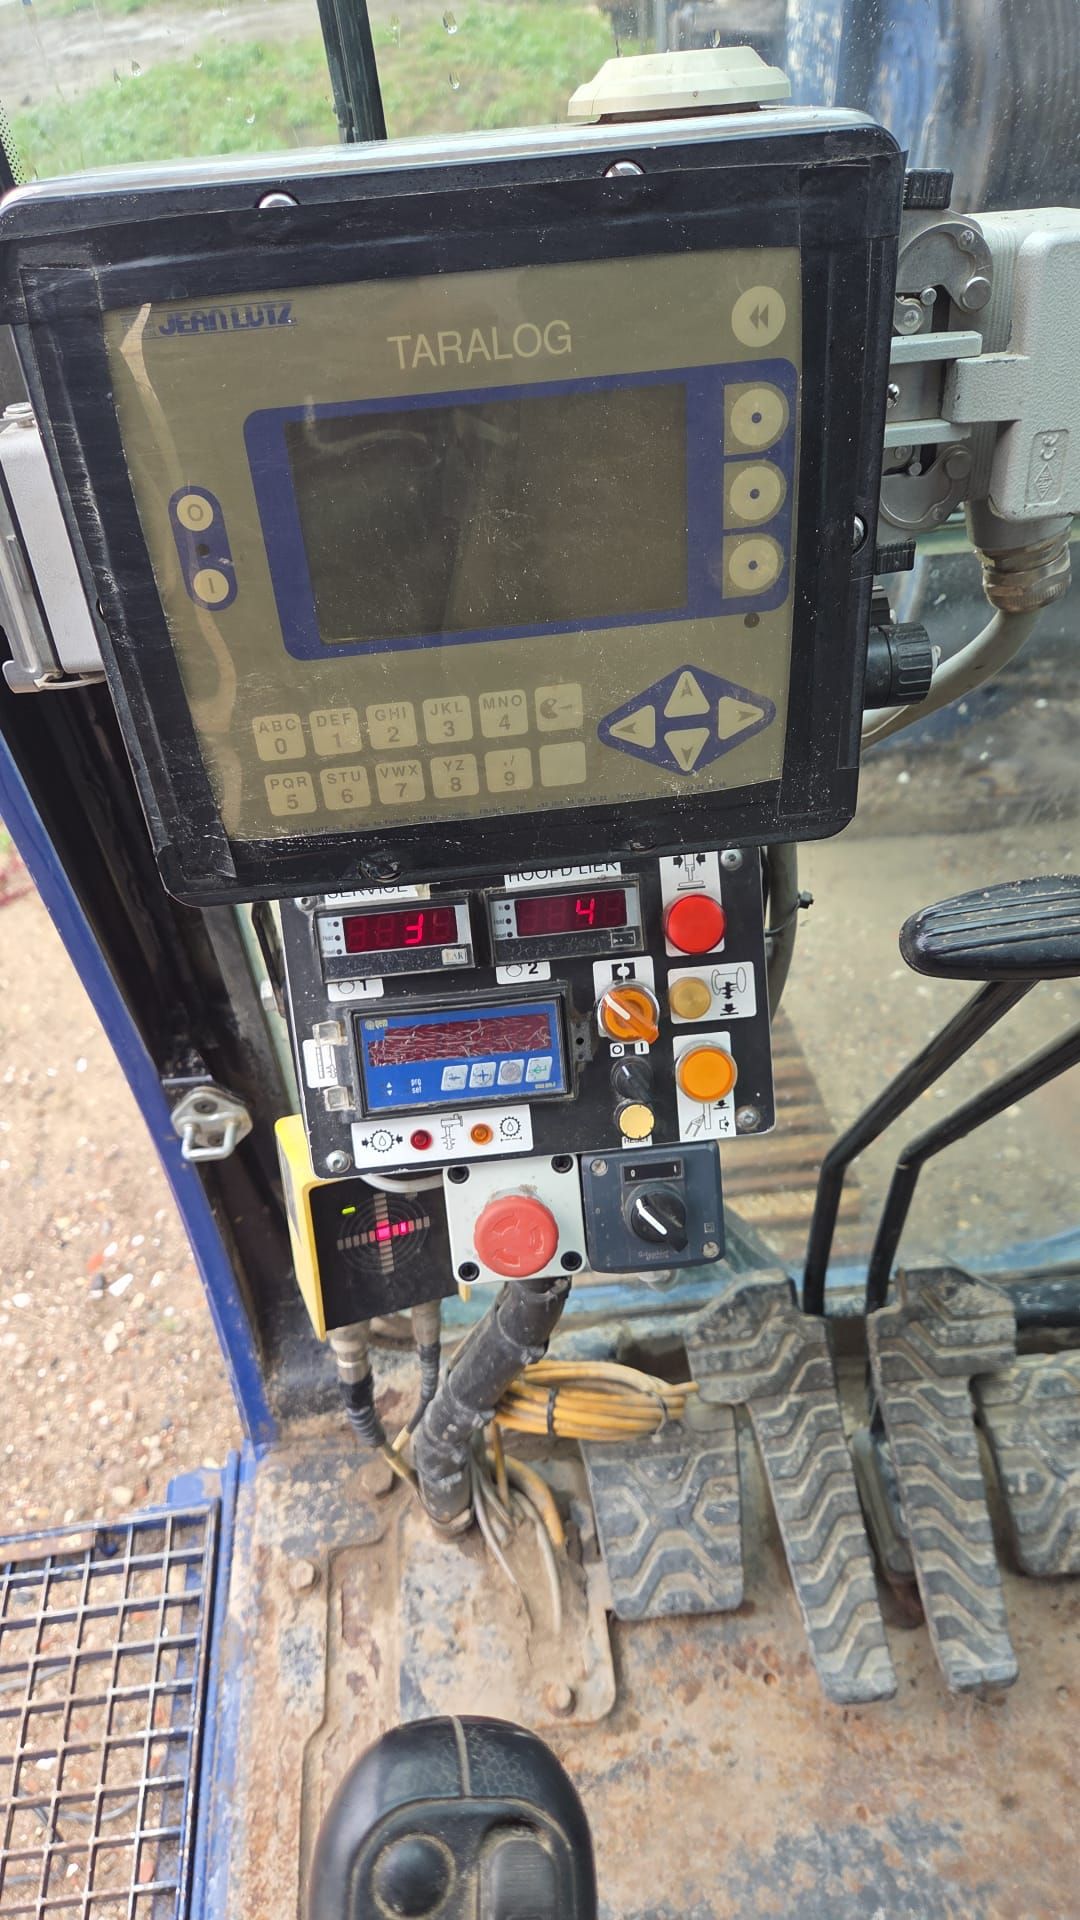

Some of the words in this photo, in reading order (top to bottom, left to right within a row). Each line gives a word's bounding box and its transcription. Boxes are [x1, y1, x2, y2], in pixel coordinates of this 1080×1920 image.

[231, 303, 293, 329] LUTZ
[387, 320, 572, 370] TARALOG
[429, 701, 464, 717] JKL
[482, 694, 523, 711] MNO
[316, 712, 351, 729] DEF
[374, 707, 407, 723] GHI
[498, 713, 511, 731] 4
[257, 718, 298, 735] ABC
[387, 726, 401, 744] 2
[443, 720, 456, 738] 3
[274, 737, 288, 756] 0
[331, 732, 342, 749] 1
[379, 763, 419, 779] VWX
[442, 759, 465, 772] YZ
[270, 776, 308, 791] PQR
[326, 771, 361, 786] STU
[450, 776, 462, 793] 8
[504, 770, 516, 787] 9
[341, 787, 354, 804] 6
[394, 781, 408, 798] 7
[286, 792, 299, 810] 5
[575, 897, 595, 925] 4
[527, 962, 539, 975] 2
